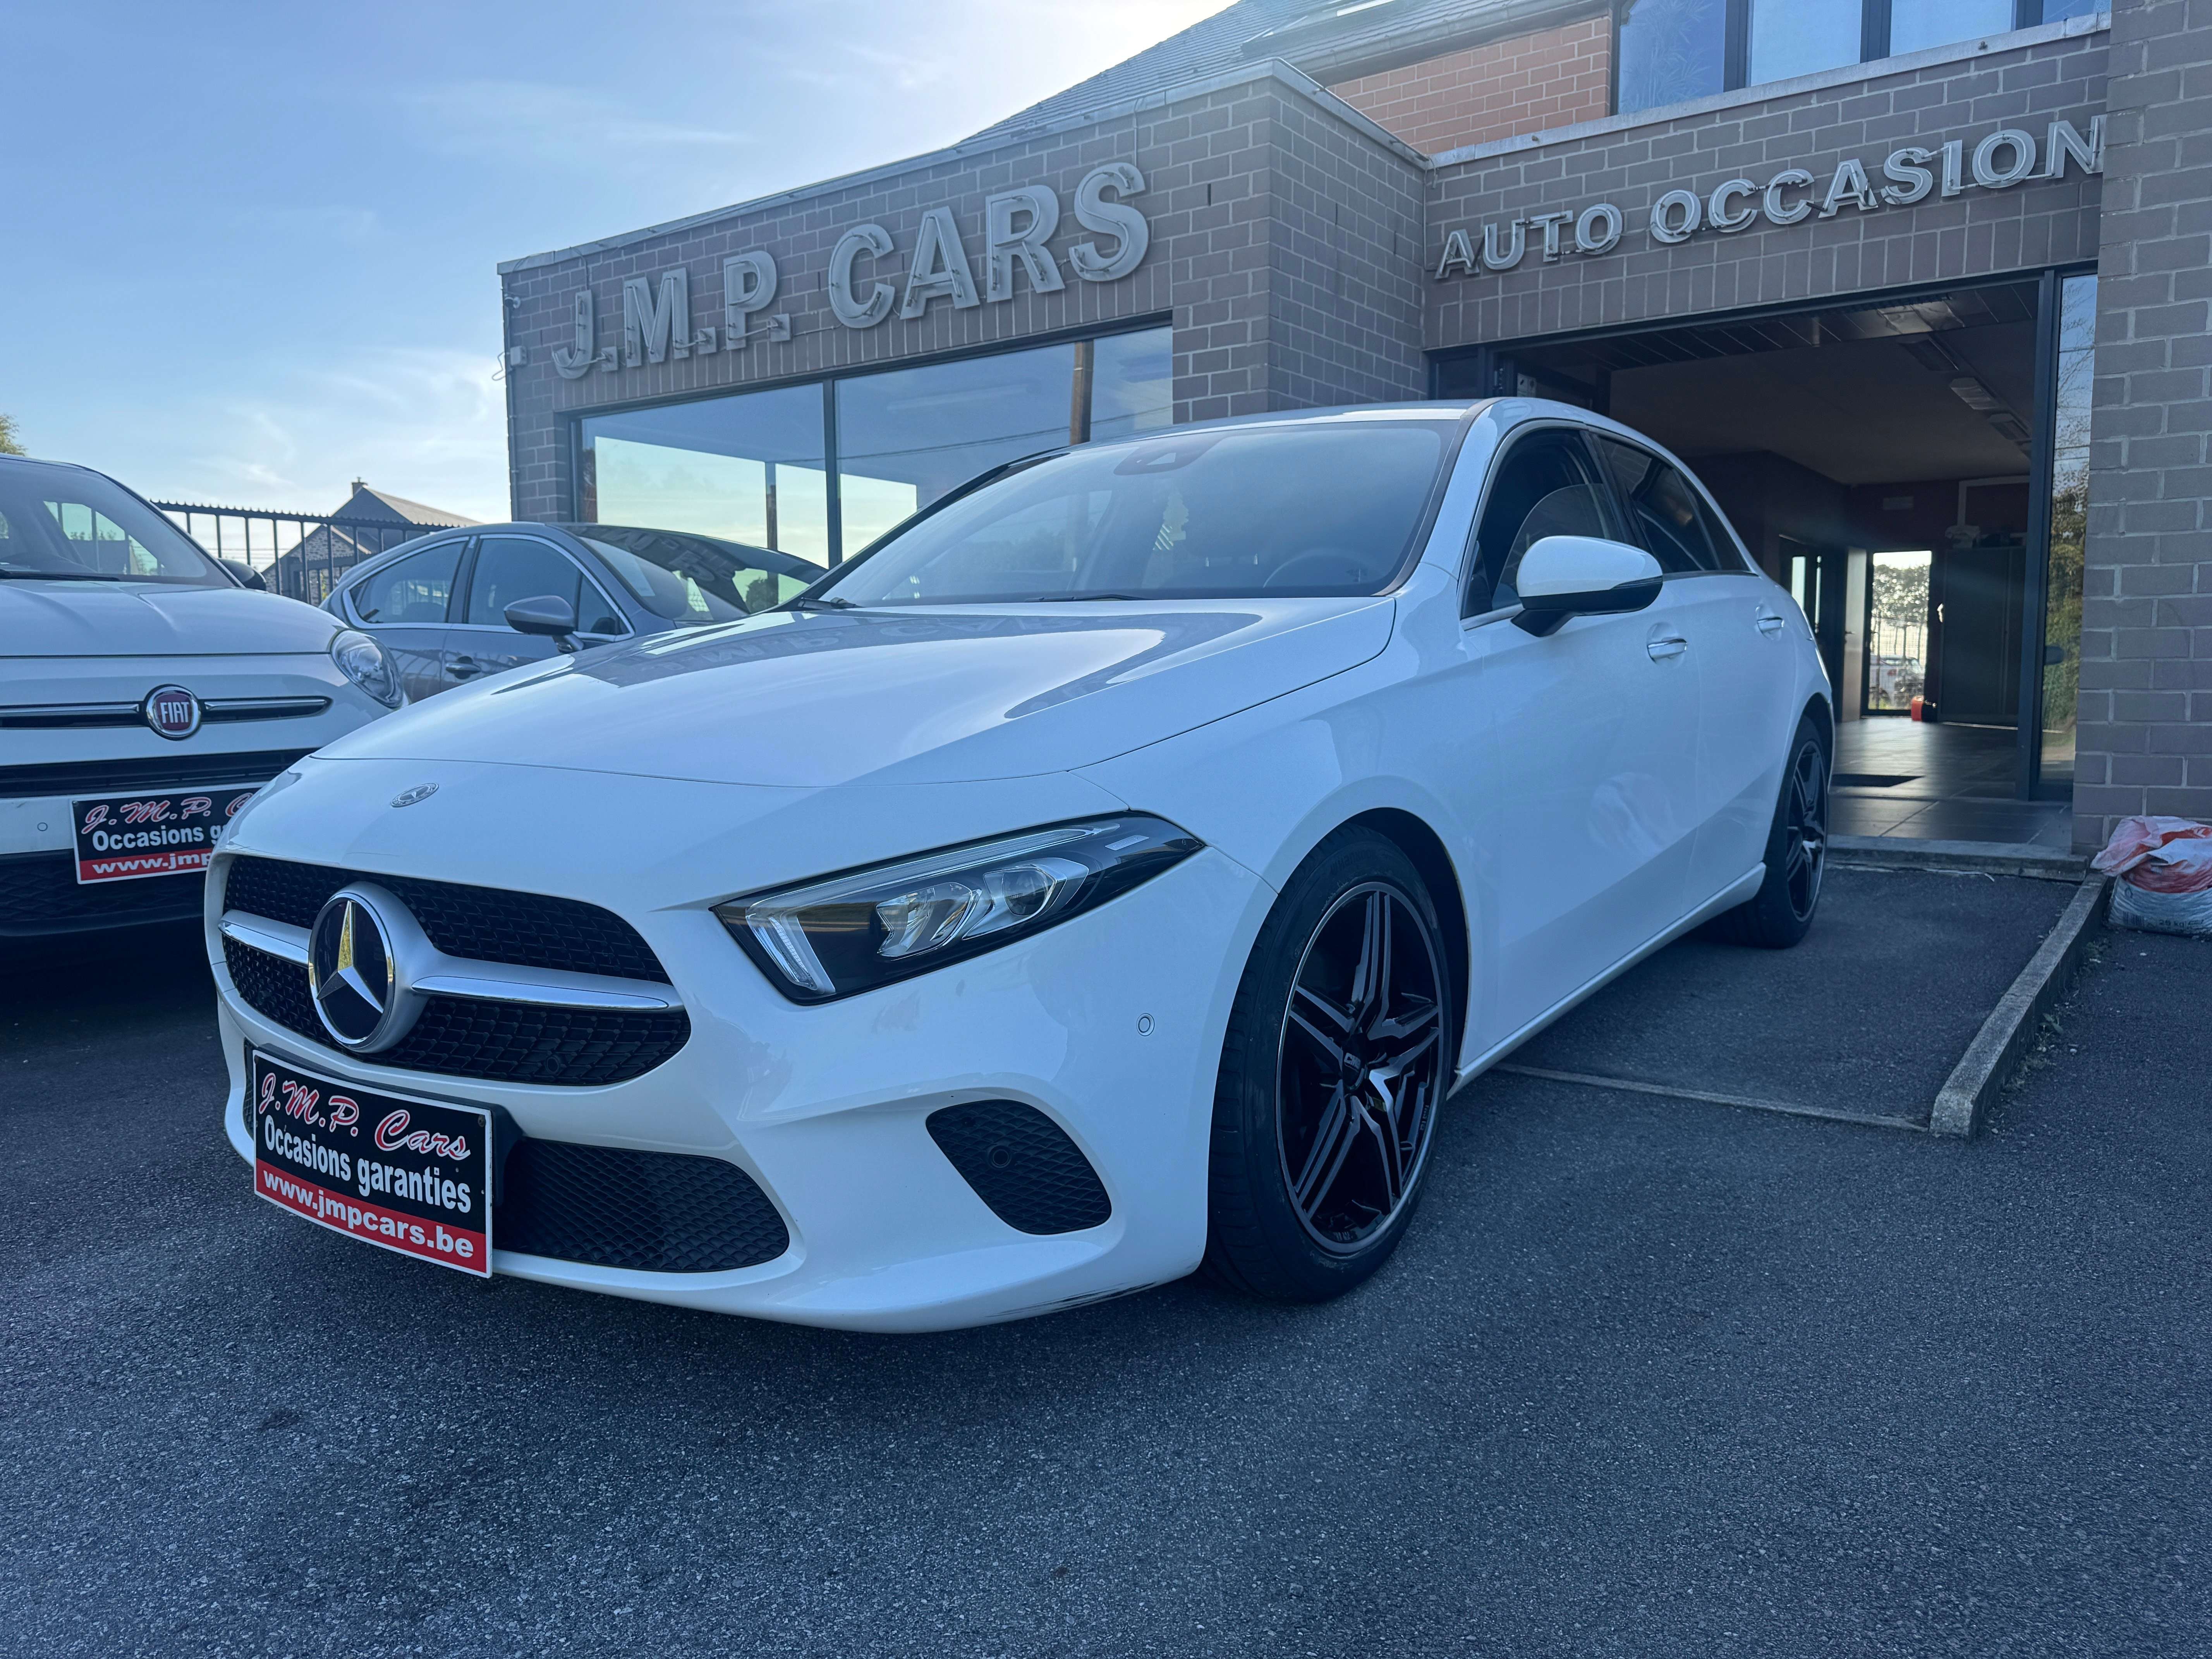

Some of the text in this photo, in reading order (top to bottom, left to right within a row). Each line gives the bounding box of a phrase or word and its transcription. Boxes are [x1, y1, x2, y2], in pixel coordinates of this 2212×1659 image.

[1434, 114, 2108, 280] AUTO OCCASION
[551, 162, 1149, 380] J.M.P. CARS
[160, 701, 189, 723] FIAT
[82, 796, 212, 834] J.M.P.
[92, 825, 204, 851] Occasions
[258, 1072, 471, 1161] J.M.P. Cars
[264, 1115, 472, 1213] Occasions garanties
[263, 1170, 474, 1258] www.jmpcars.be
